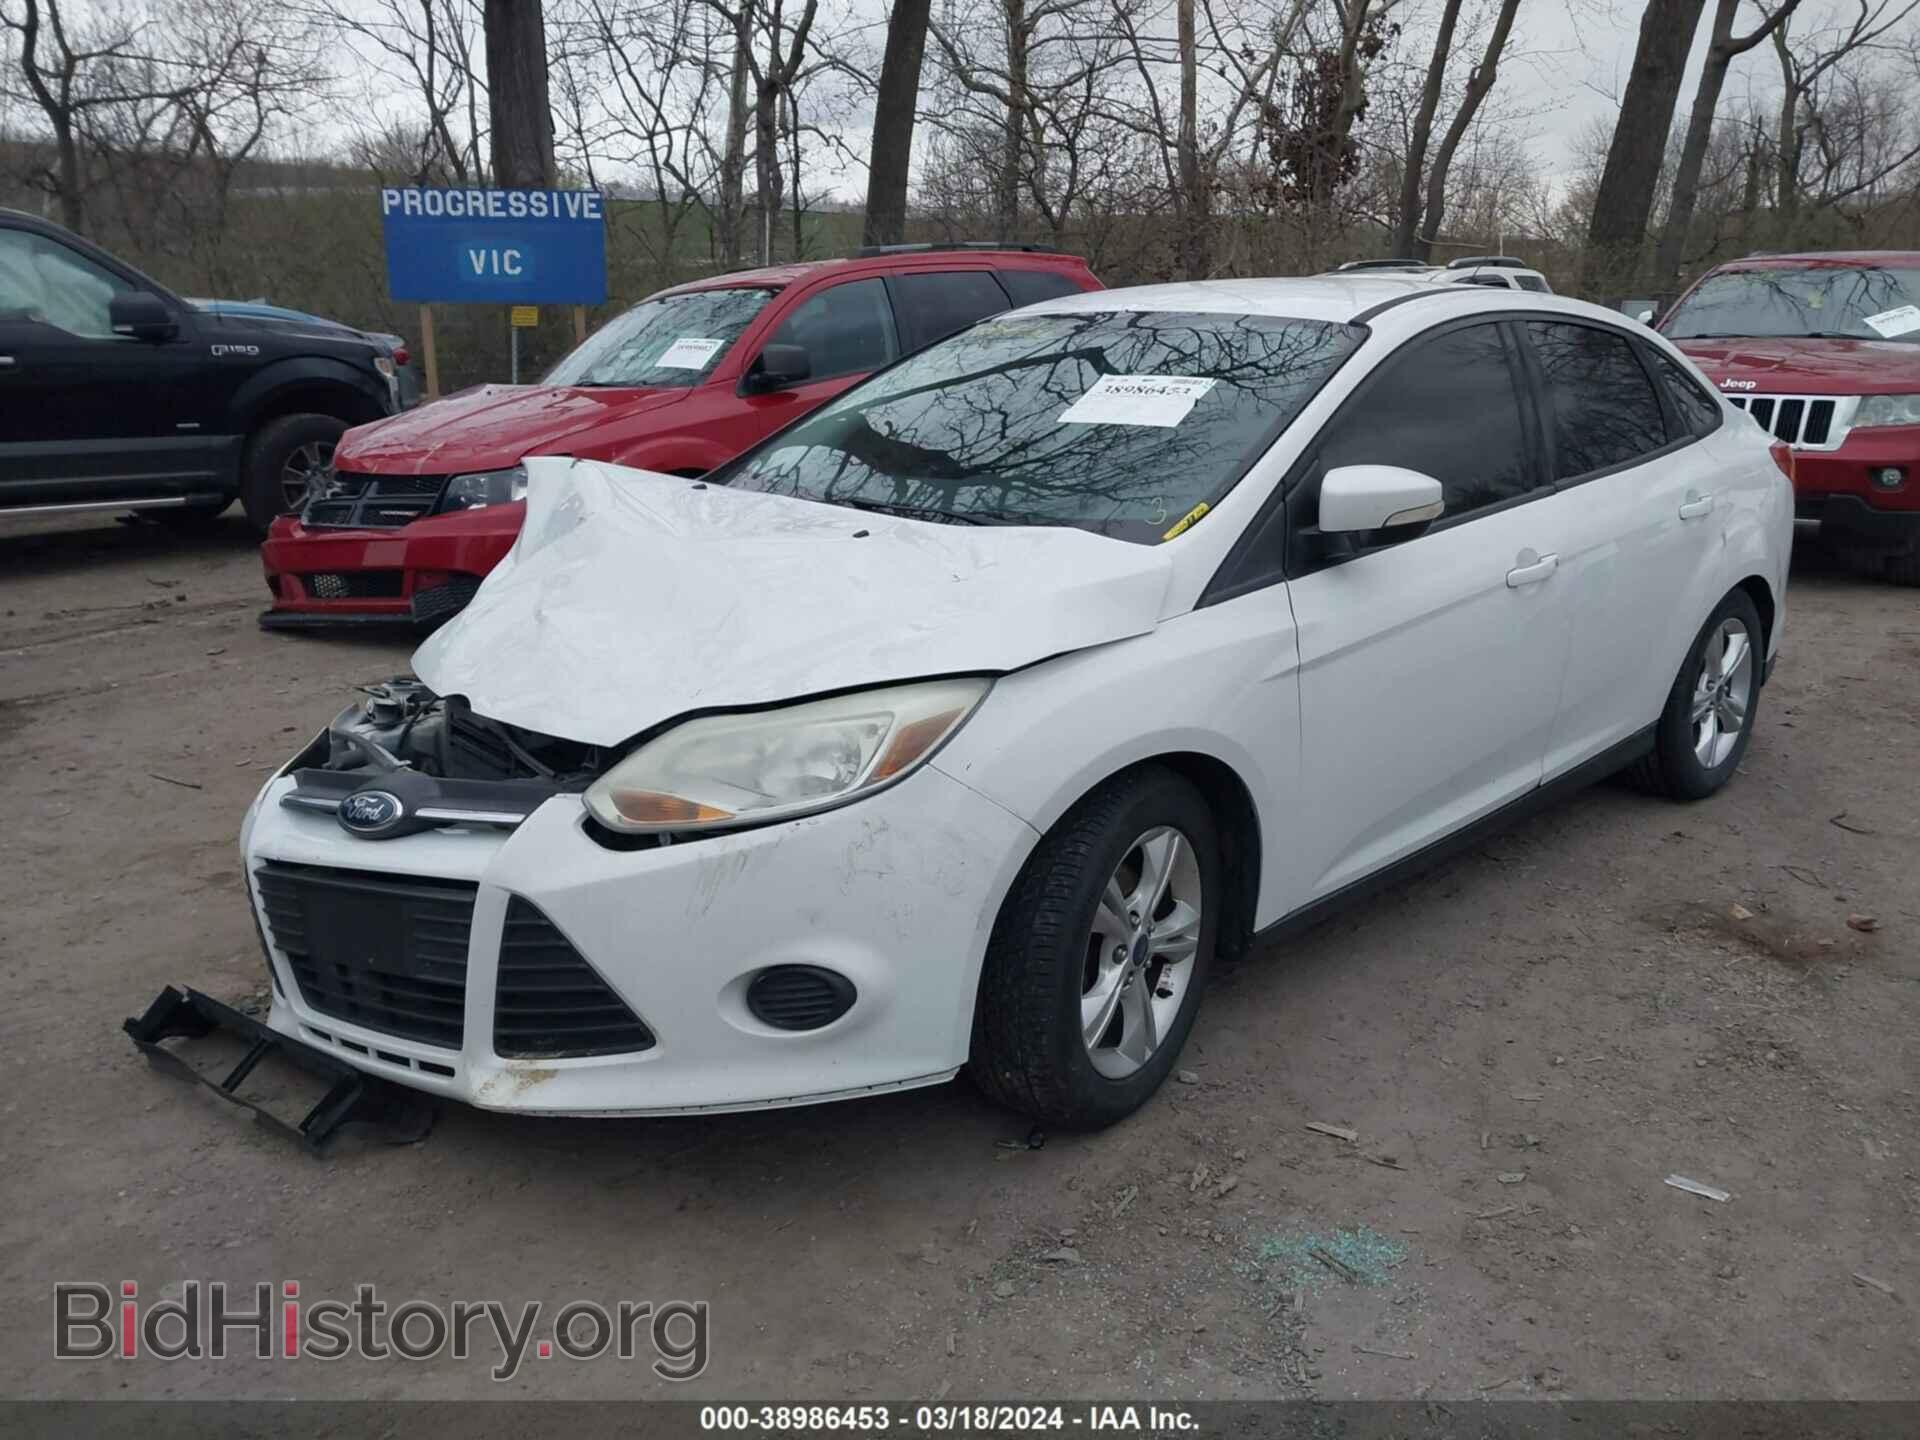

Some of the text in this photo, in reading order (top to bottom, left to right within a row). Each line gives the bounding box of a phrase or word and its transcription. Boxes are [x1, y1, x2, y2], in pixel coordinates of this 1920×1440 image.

[382, 188, 602, 219] PROGRESSIVE
[469, 248, 523, 276] VIC
[1719, 378, 1757, 390] Jeep
[1144, 496, 1167, 525] 3
[346, 795, 385, 821] Ford
